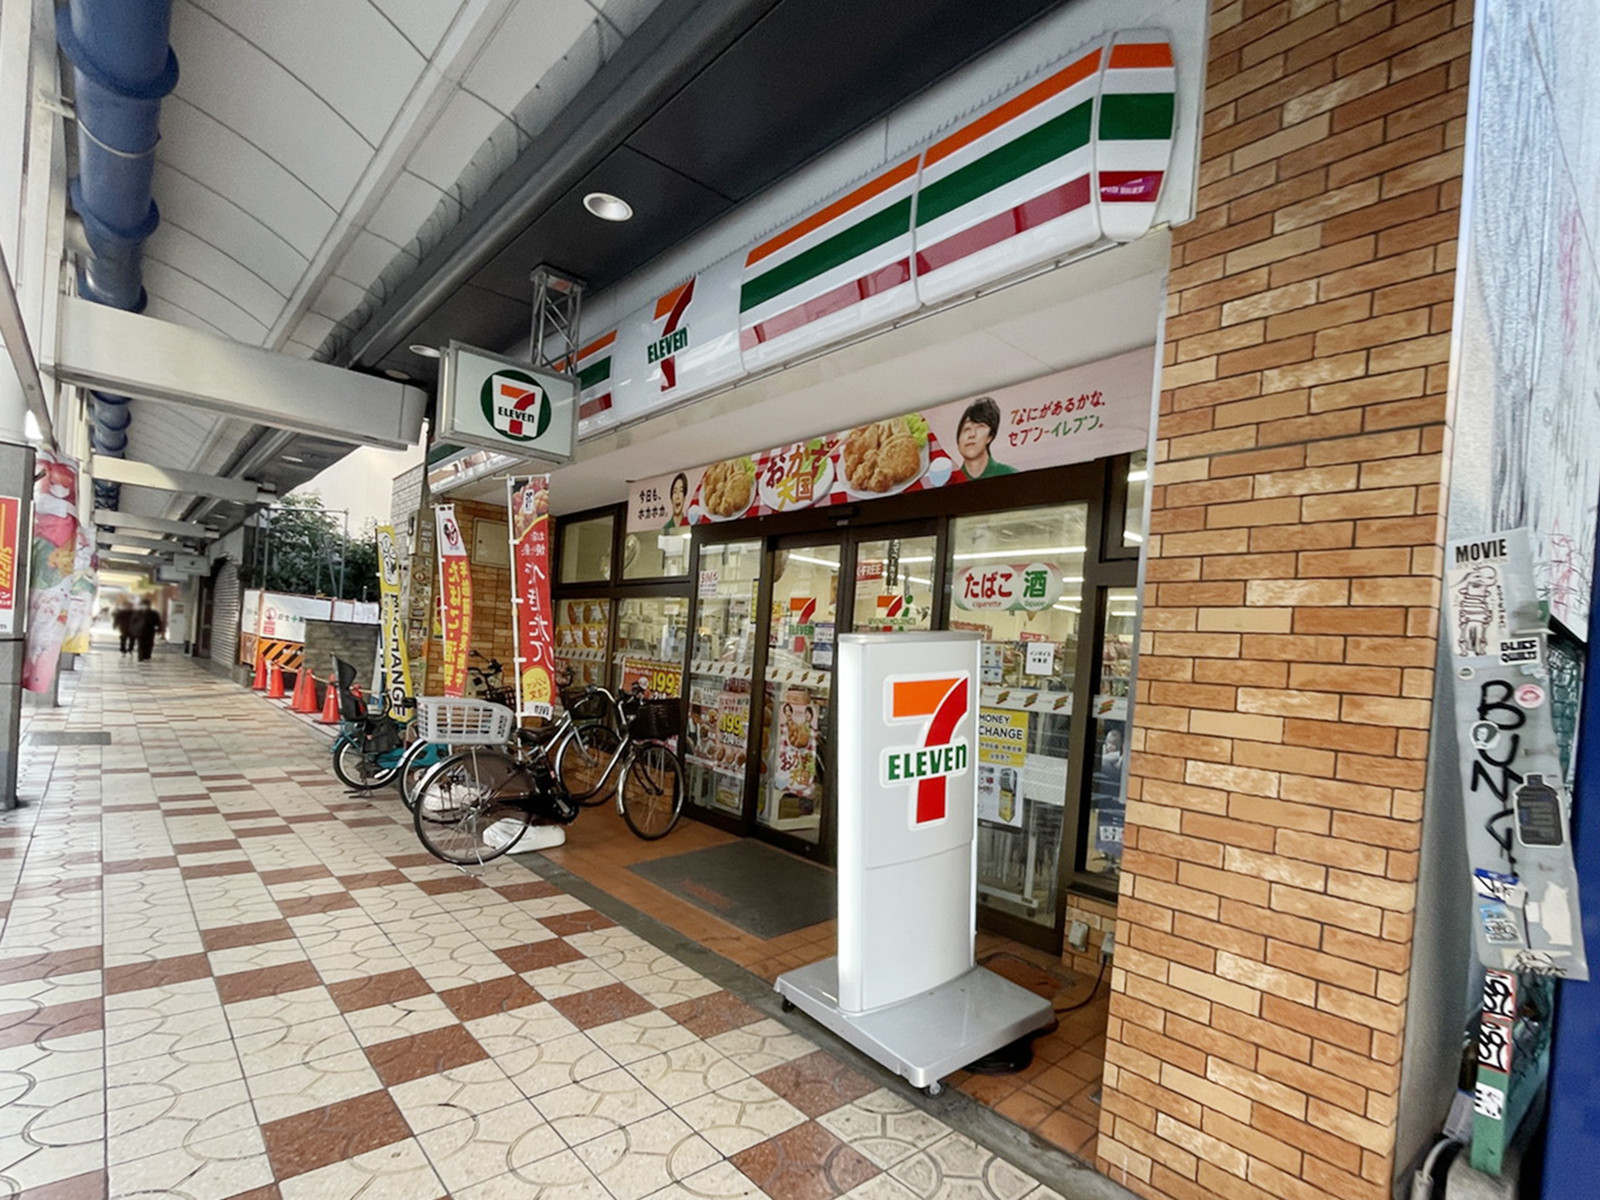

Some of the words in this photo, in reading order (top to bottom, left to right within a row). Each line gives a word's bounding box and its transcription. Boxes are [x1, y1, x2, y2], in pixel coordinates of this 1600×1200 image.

[775, 470, 813, 511] 天国
[1456, 539, 1507, 563] MOVIE
[964, 571, 1013, 598] たばこ
[1023, 570, 1047, 598] 酒
[652, 671, 675, 694] 199
[979, 725, 1023, 740] CHANGE
[892, 677, 968, 824] 7
